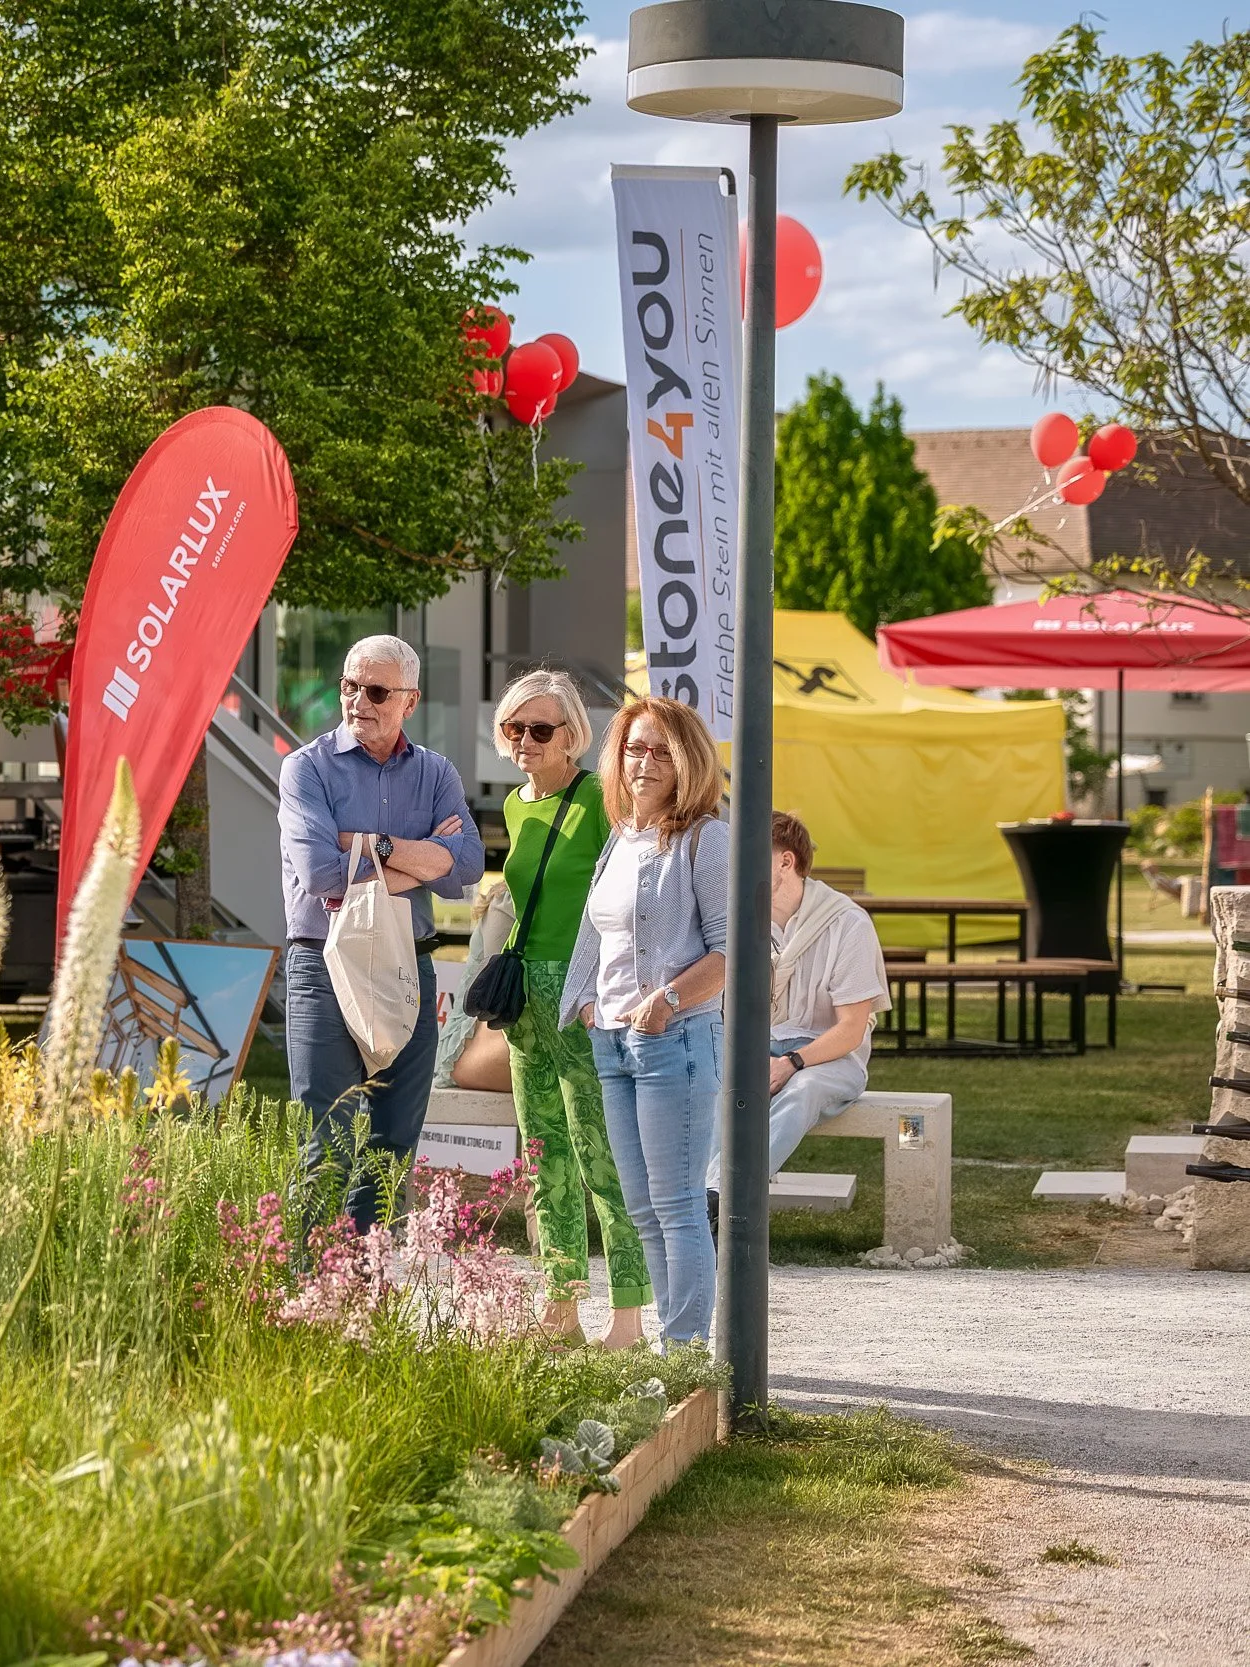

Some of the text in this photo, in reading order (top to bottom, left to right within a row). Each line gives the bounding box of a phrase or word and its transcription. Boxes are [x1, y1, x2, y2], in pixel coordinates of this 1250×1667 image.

[126, 475, 231, 673] SOLARLUX
[211, 500, 247, 569] solarlux.com
[694, 232, 735, 719] Erlebe Stein mit allen Sinnen
